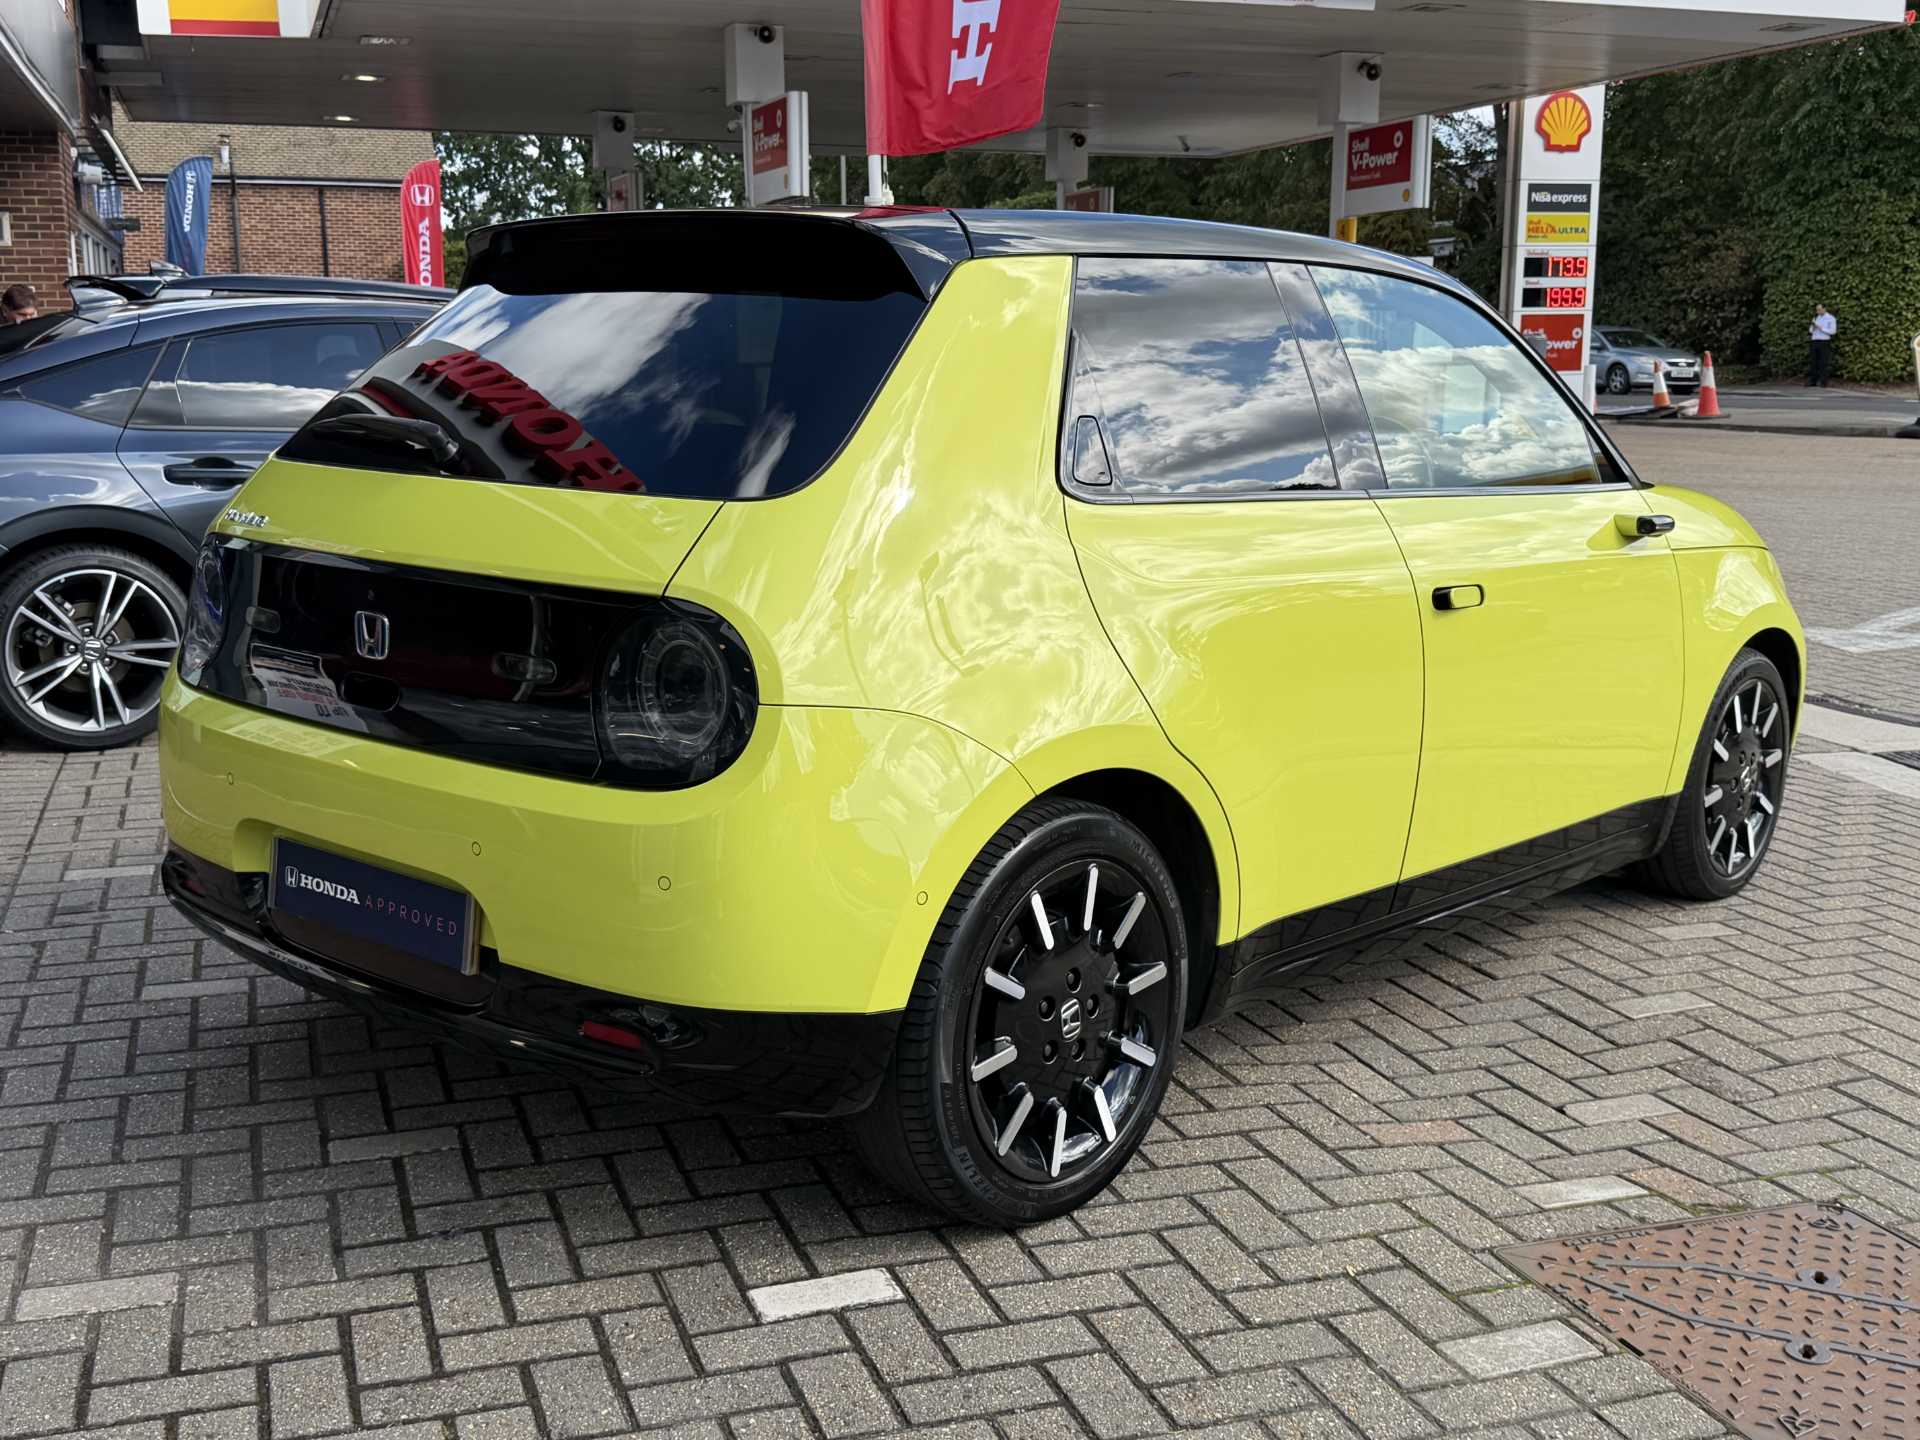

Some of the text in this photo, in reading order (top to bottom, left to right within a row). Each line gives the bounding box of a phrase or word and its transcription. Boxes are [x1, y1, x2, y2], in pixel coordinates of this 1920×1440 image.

[1352, 137, 1370, 153] Shell
[1352, 150, 1399, 171] V-Power
[183, 183, 194, 232] HONDA
[418, 217, 432, 287] ONDA
[1548, 257, 1587, 277] 173.9
[1546, 287, 1586, 308] 199.9
[300, 873, 457, 936] HONDA APPROVED
